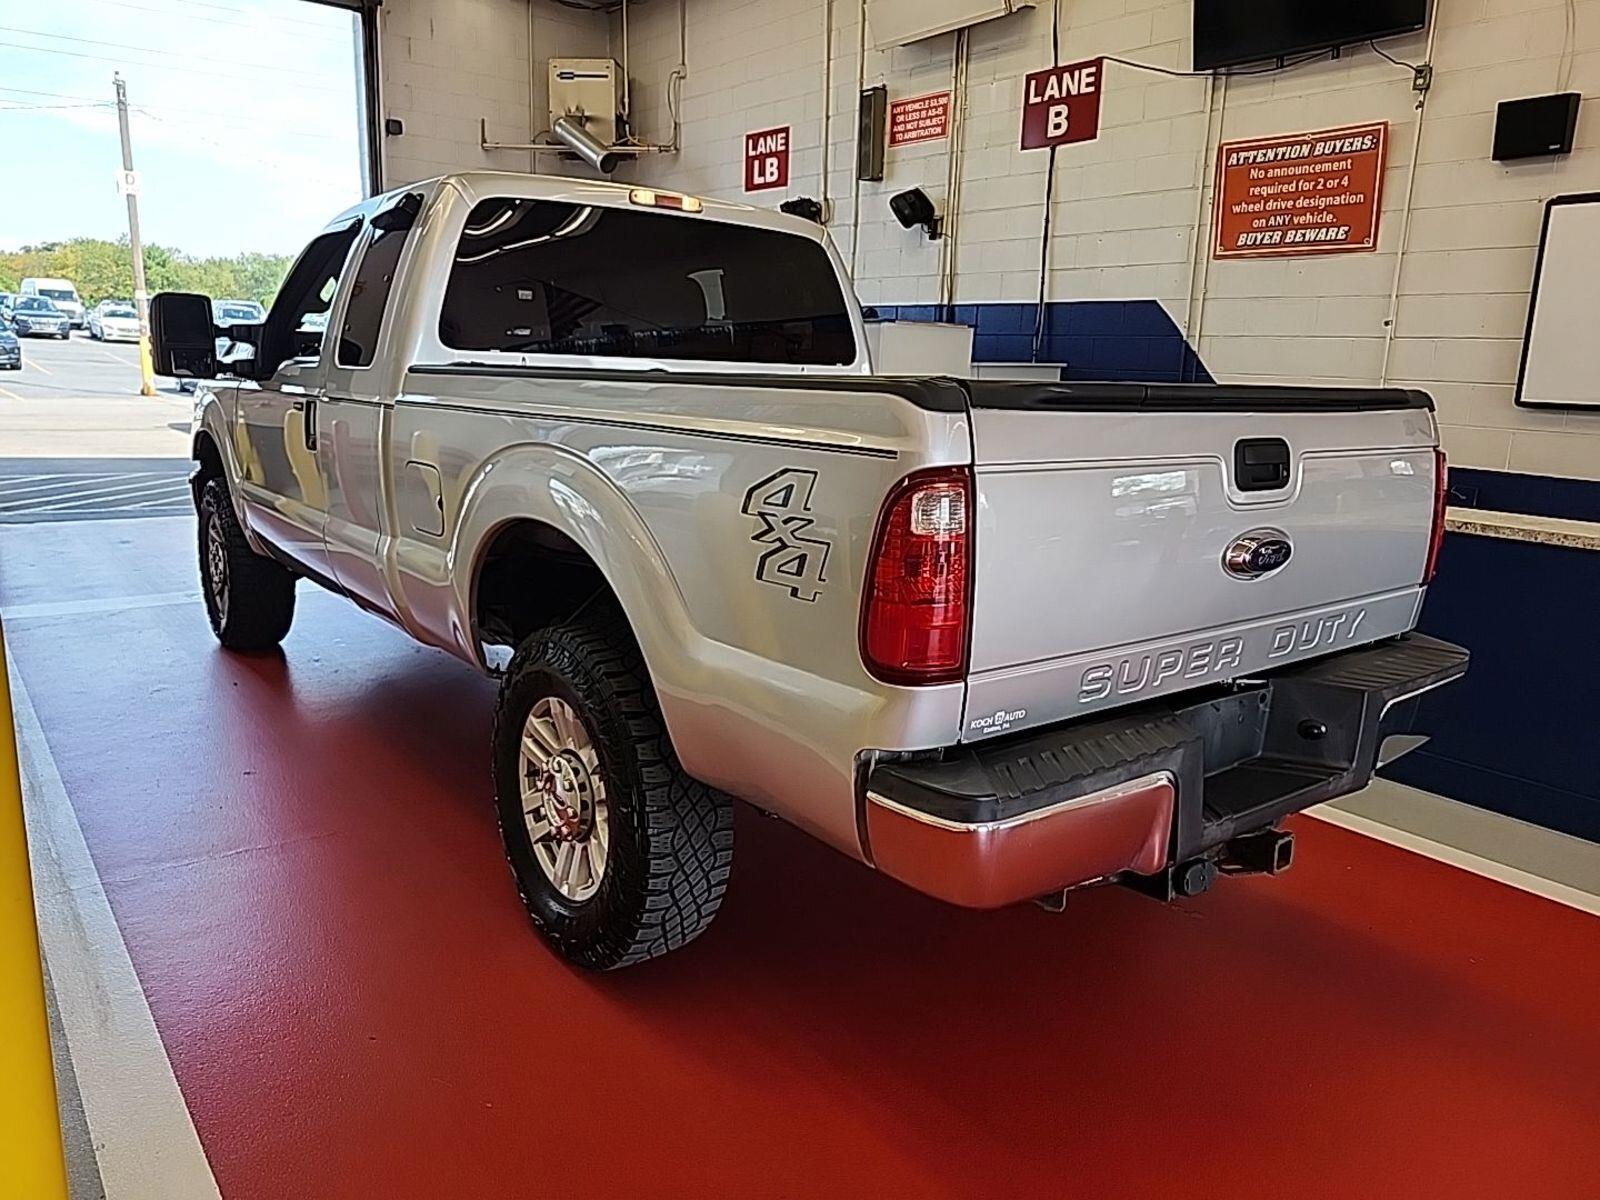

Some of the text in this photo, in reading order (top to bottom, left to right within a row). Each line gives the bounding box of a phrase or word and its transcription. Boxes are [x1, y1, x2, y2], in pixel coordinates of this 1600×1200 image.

[1028, 66, 1097, 104] LANE
[896, 114, 905, 122] OR
[905, 111, 920, 121] LESS
[905, 101, 930, 112] VEHICLE
[893, 116, 946, 132] AND NOT SUBJECT
[1047, 104, 1069, 138] B
[748, 132, 786, 156] LANE
[895, 126, 942, 141] TO ARBITRATION
[1228, 135, 1378, 166] ATTENTION BUYERS:
[753, 157, 779, 185] LB
[1250, 159, 1352, 179] No announcement
[1250, 176, 1349, 197] required for 2 or 4
[1232, 192, 1364, 214] wheel drive designation
[1252, 211, 1337, 228] on ANY vehicle.
[1237, 226, 1349, 247] BUYER BEWARE
[1077, 609, 1367, 703] SUPER DUTY
[970, 716, 994, 729] KOCH
[1004, 709, 1026, 721] AUTO
